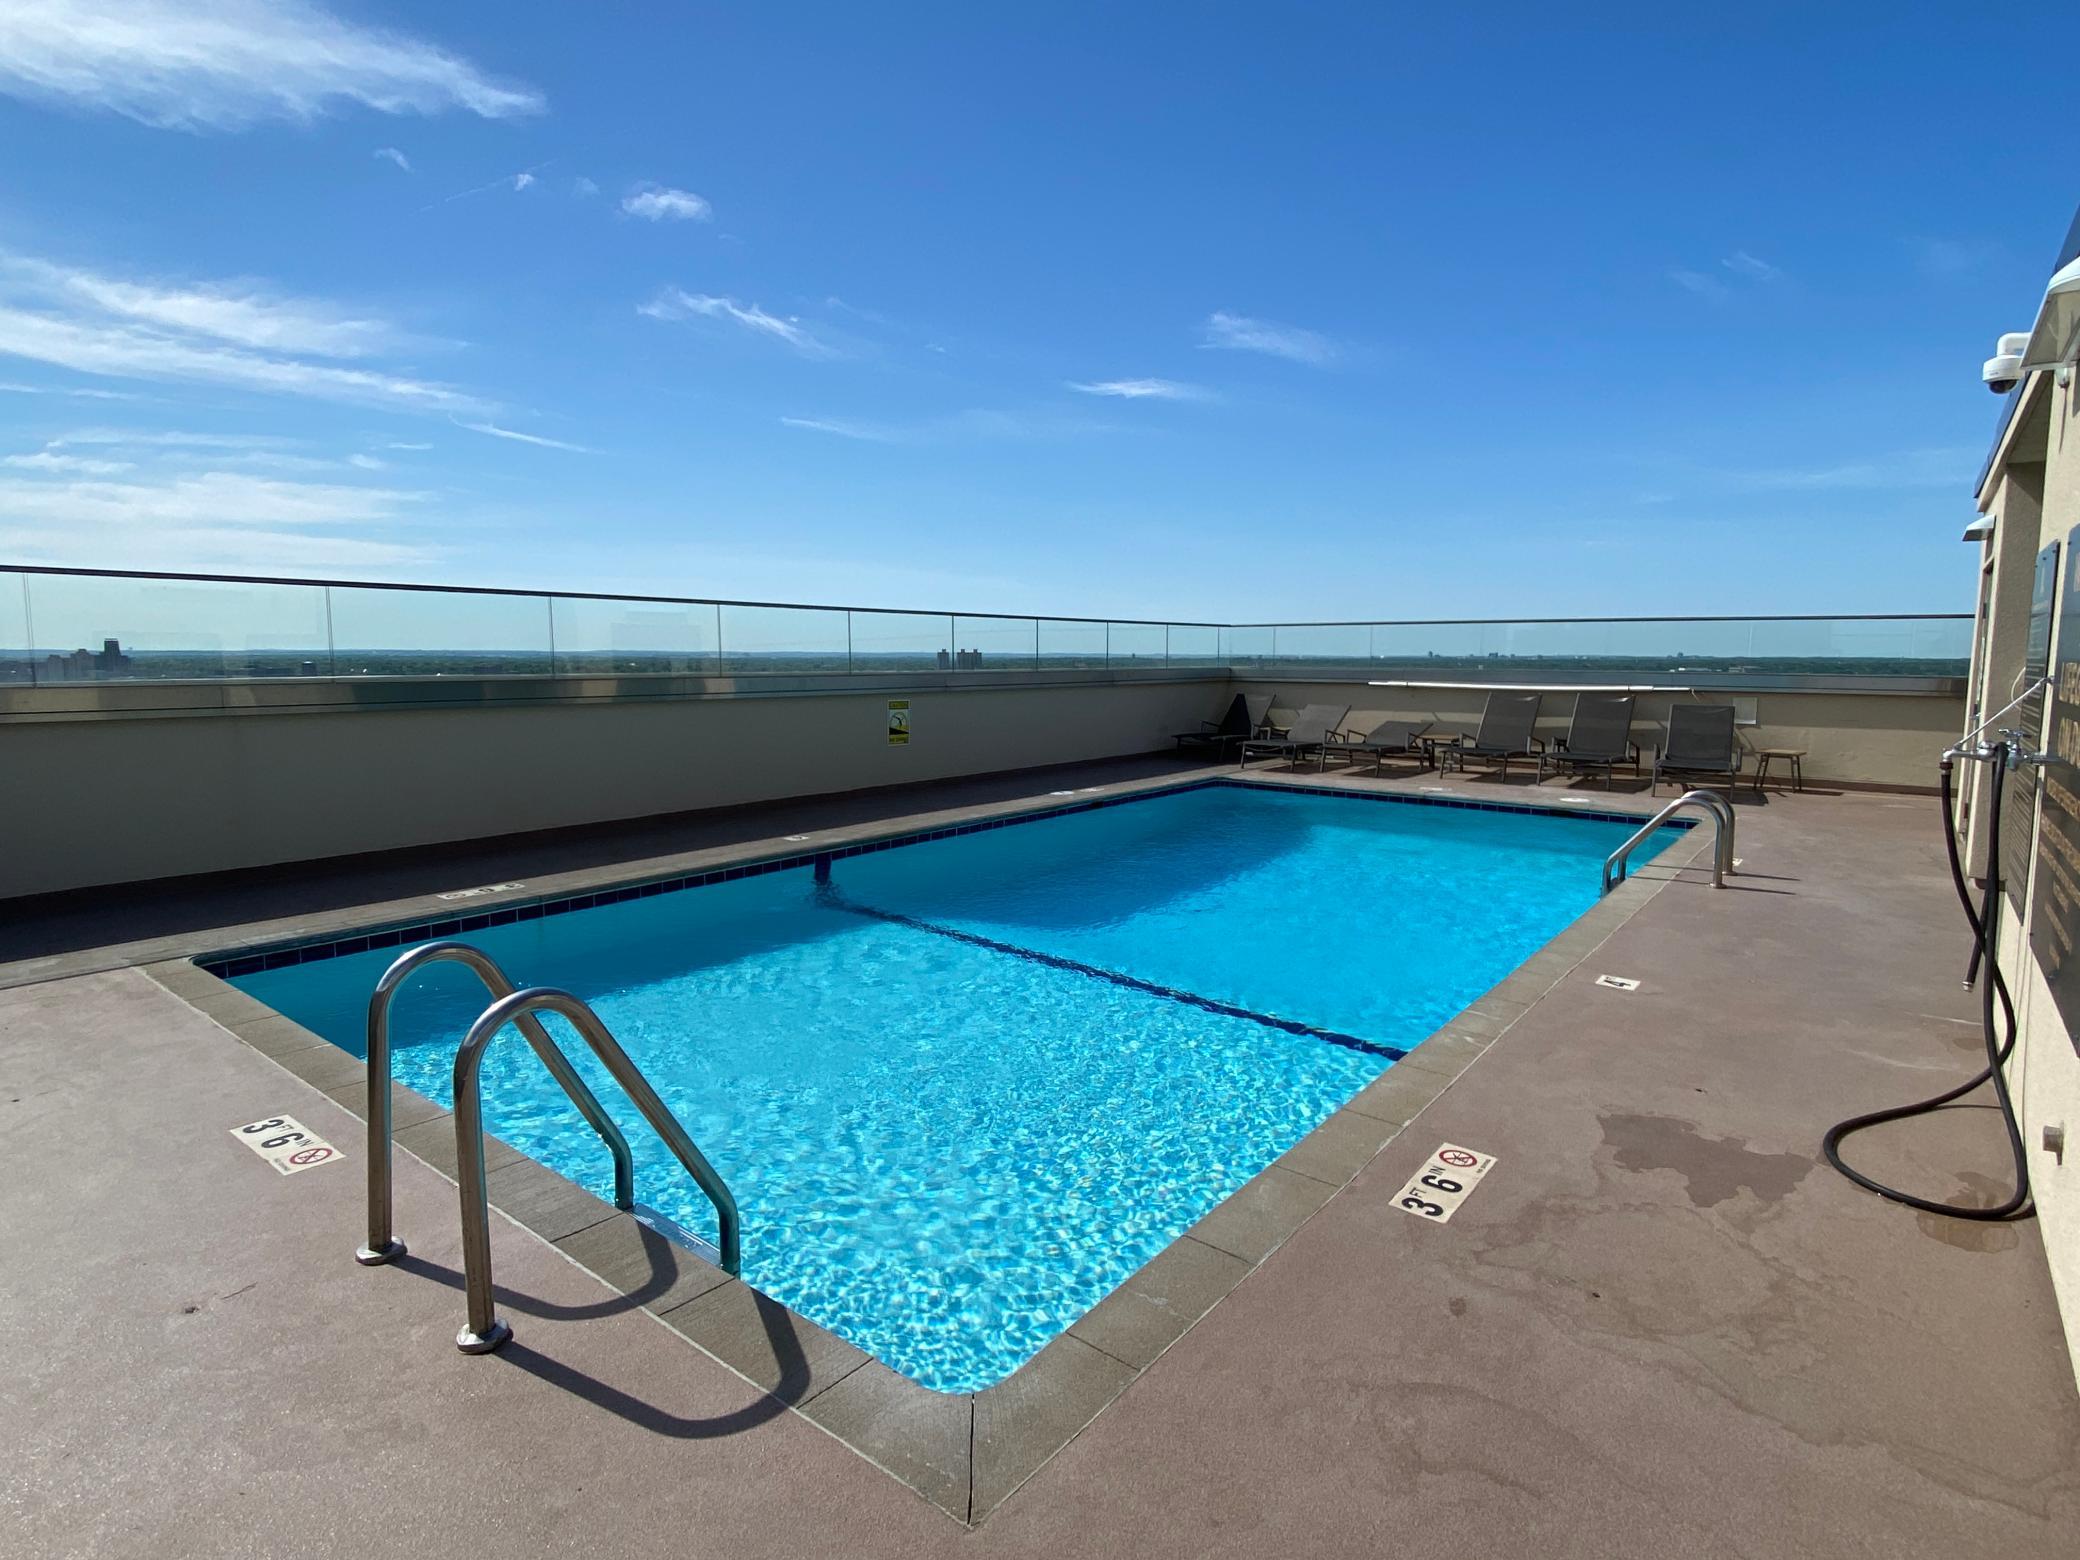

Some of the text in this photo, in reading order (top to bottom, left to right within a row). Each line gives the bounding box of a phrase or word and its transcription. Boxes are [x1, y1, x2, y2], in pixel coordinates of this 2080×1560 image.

[243, 1119, 284, 1133] 3
[261, 1132, 304, 1148] 6
[1401, 1165, 1463, 1217] 3 FT 6 IN
